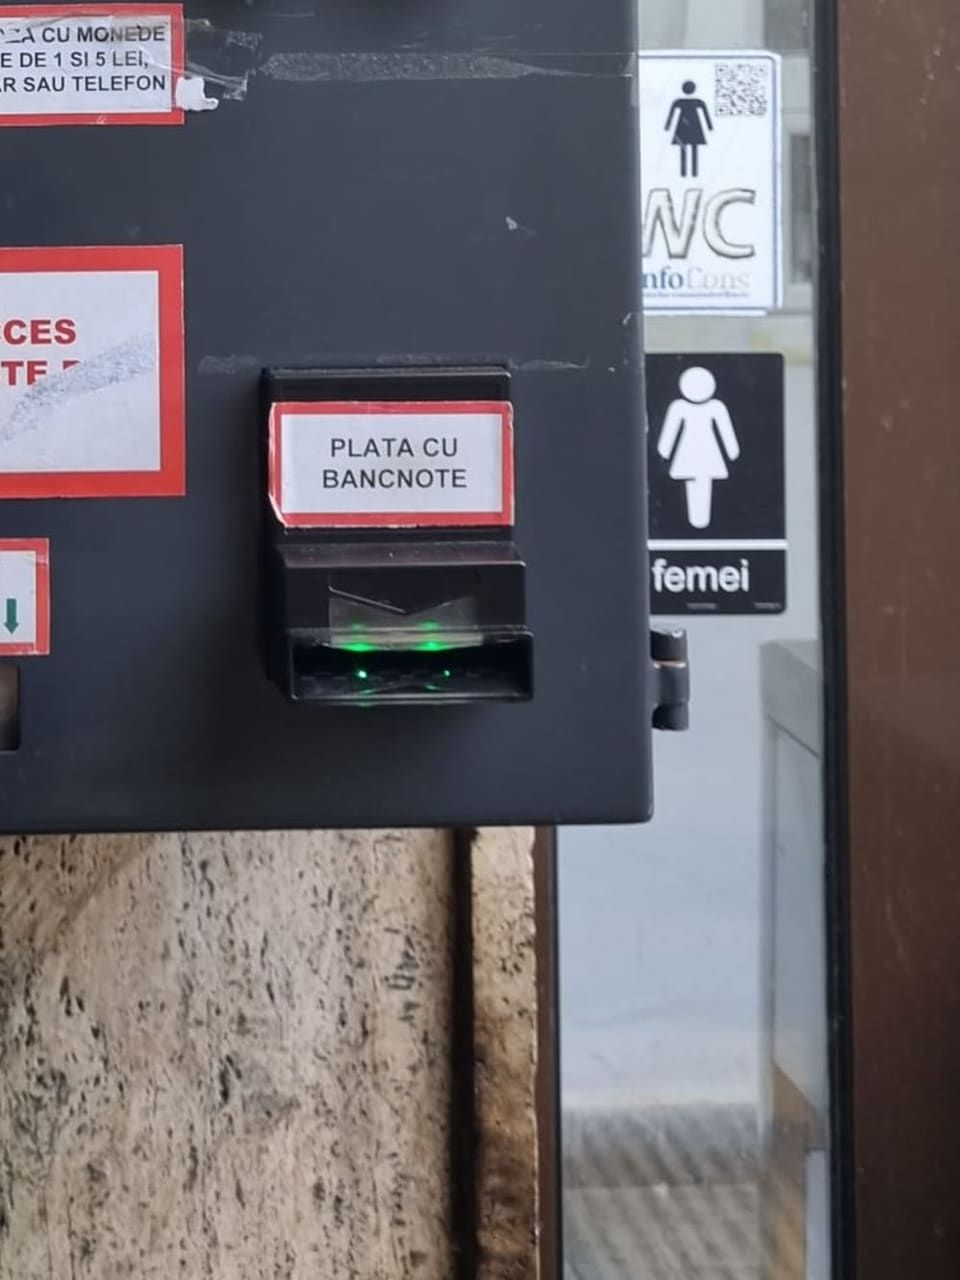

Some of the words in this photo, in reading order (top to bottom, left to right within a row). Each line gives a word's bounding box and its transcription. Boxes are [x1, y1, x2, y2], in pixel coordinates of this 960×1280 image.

[42, 27, 70, 43] CU
[77, 25, 165, 43] MONEDE
[20, 52, 46, 68] DE
[54, 52, 62, 67] 1
[70, 51, 88, 67] SI
[96, 51, 106, 67] 5
[112, 50, 149, 68] LEI,
[24, 76, 65, 92] SAU
[72, 75, 166, 91] TELEFON
[641, 187, 756, 260] WC
[642, 266, 751, 291] nfoCons
[330, 438, 414, 458] PLATA
[423, 438, 458, 458] CU
[322, 469, 467, 489] BANCNOTE
[651, 558, 749, 593] femei
